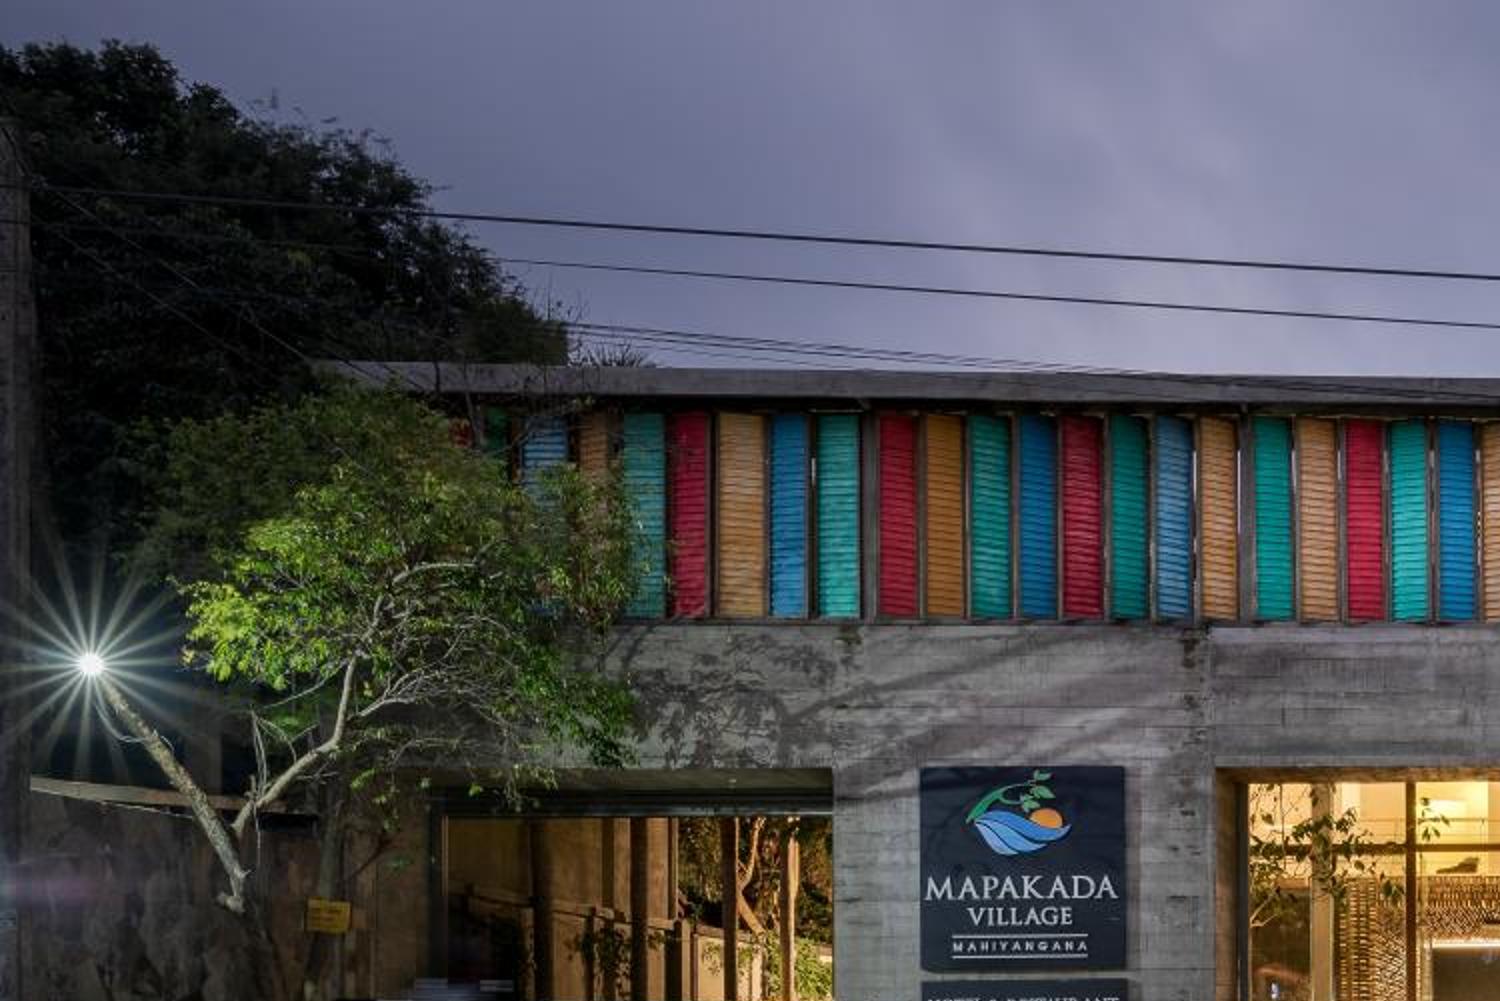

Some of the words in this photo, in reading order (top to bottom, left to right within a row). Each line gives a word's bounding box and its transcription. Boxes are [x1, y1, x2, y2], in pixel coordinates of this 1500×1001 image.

[925, 875, 1119, 901] MAPAKADA
[966, 906, 1073, 927] VILLAGE
[952, 941, 1088, 953] MAHIYANGANA
